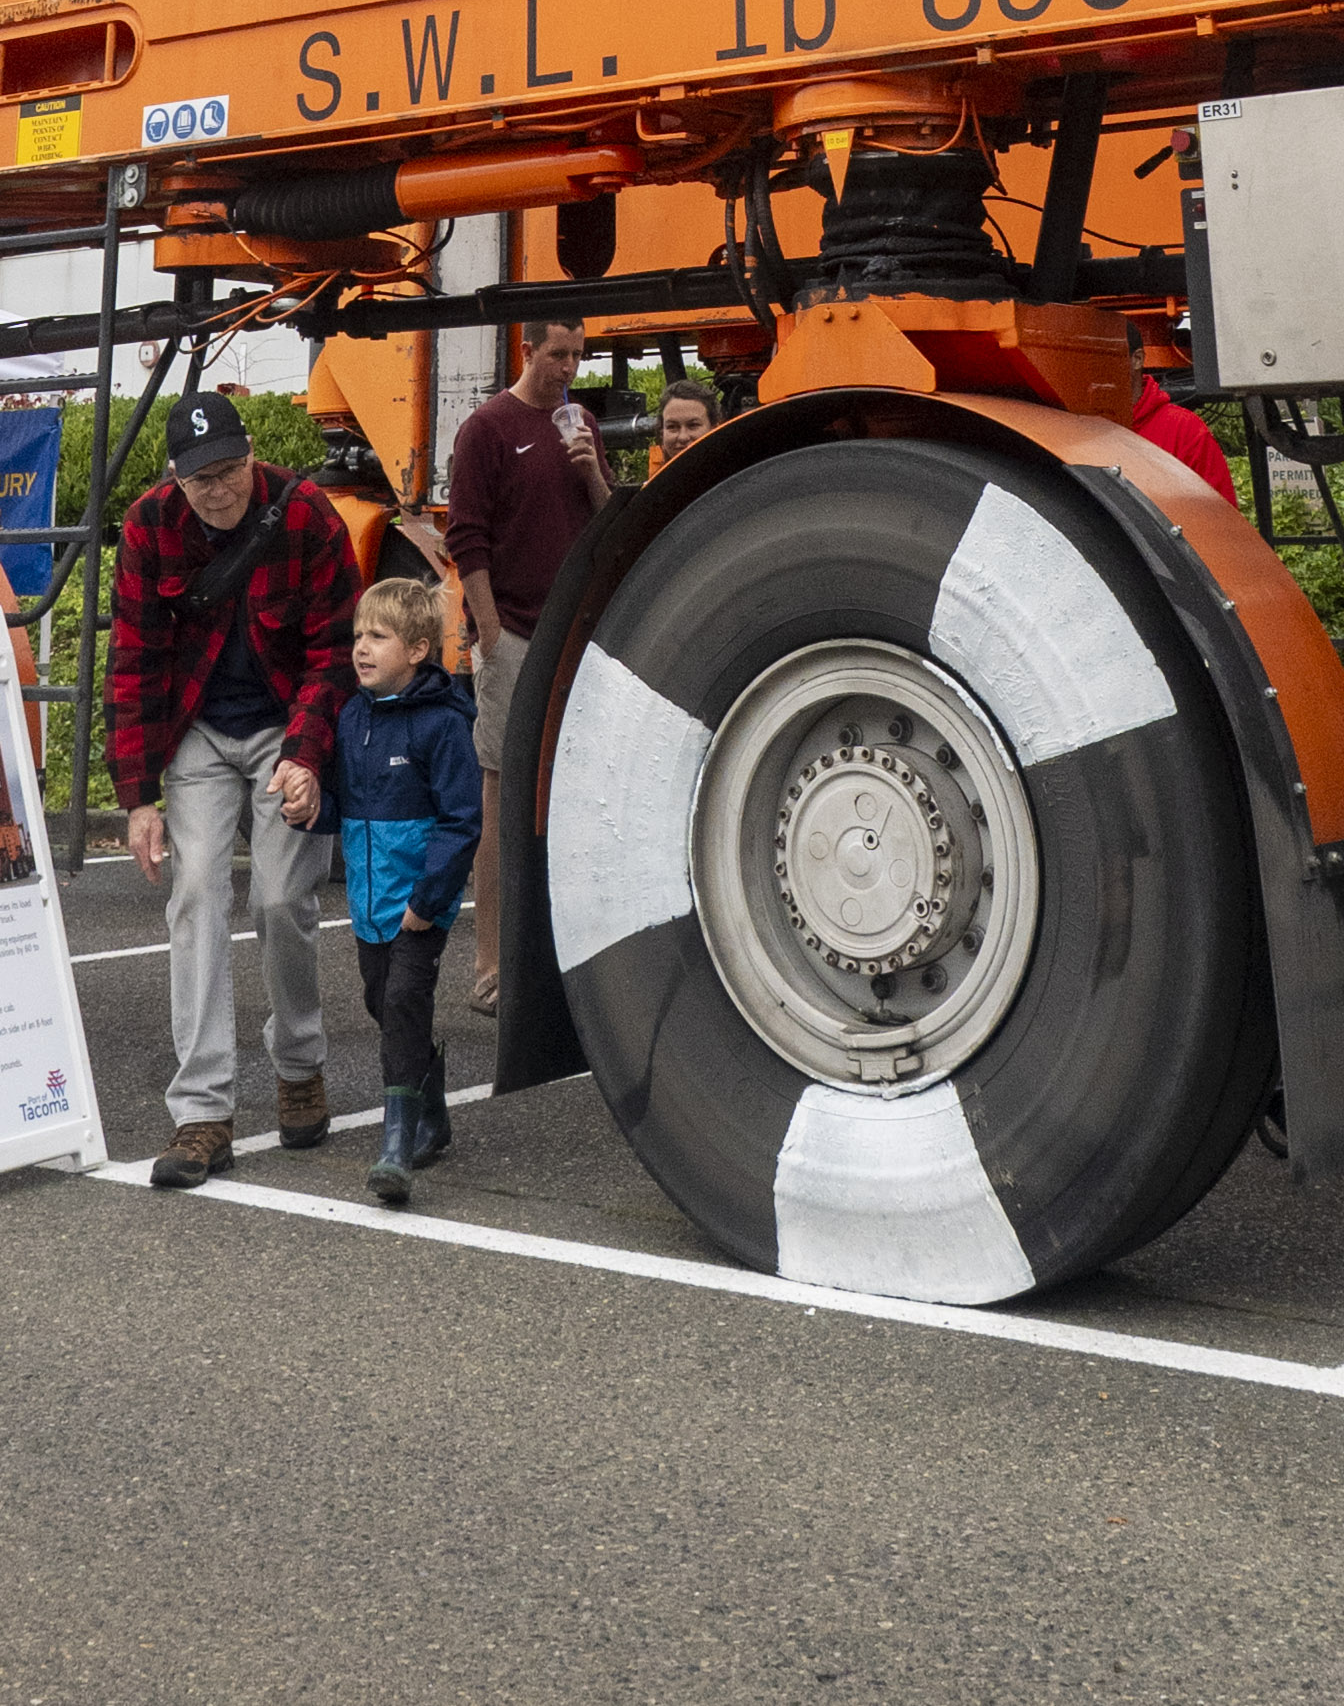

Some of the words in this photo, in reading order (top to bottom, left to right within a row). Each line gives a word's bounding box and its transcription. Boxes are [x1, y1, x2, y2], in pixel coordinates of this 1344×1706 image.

[36, 100, 66, 112] CAUTION
[1201, 103, 1240, 120] ER31
[32, 117, 63, 126] MAINTAIN
[33, 127, 55, 135] POINTS
[34, 134, 62, 144] CONTACT
[31, 152, 63, 161] CLIMBING
[191, 408, 209, 437] S
[1273, 470, 1314, 480] PERMIT
[27, 1093, 41, 1104] Port
[41, 1091, 47, 1100] of
[19, 1097, 70, 1122] Tacoma
